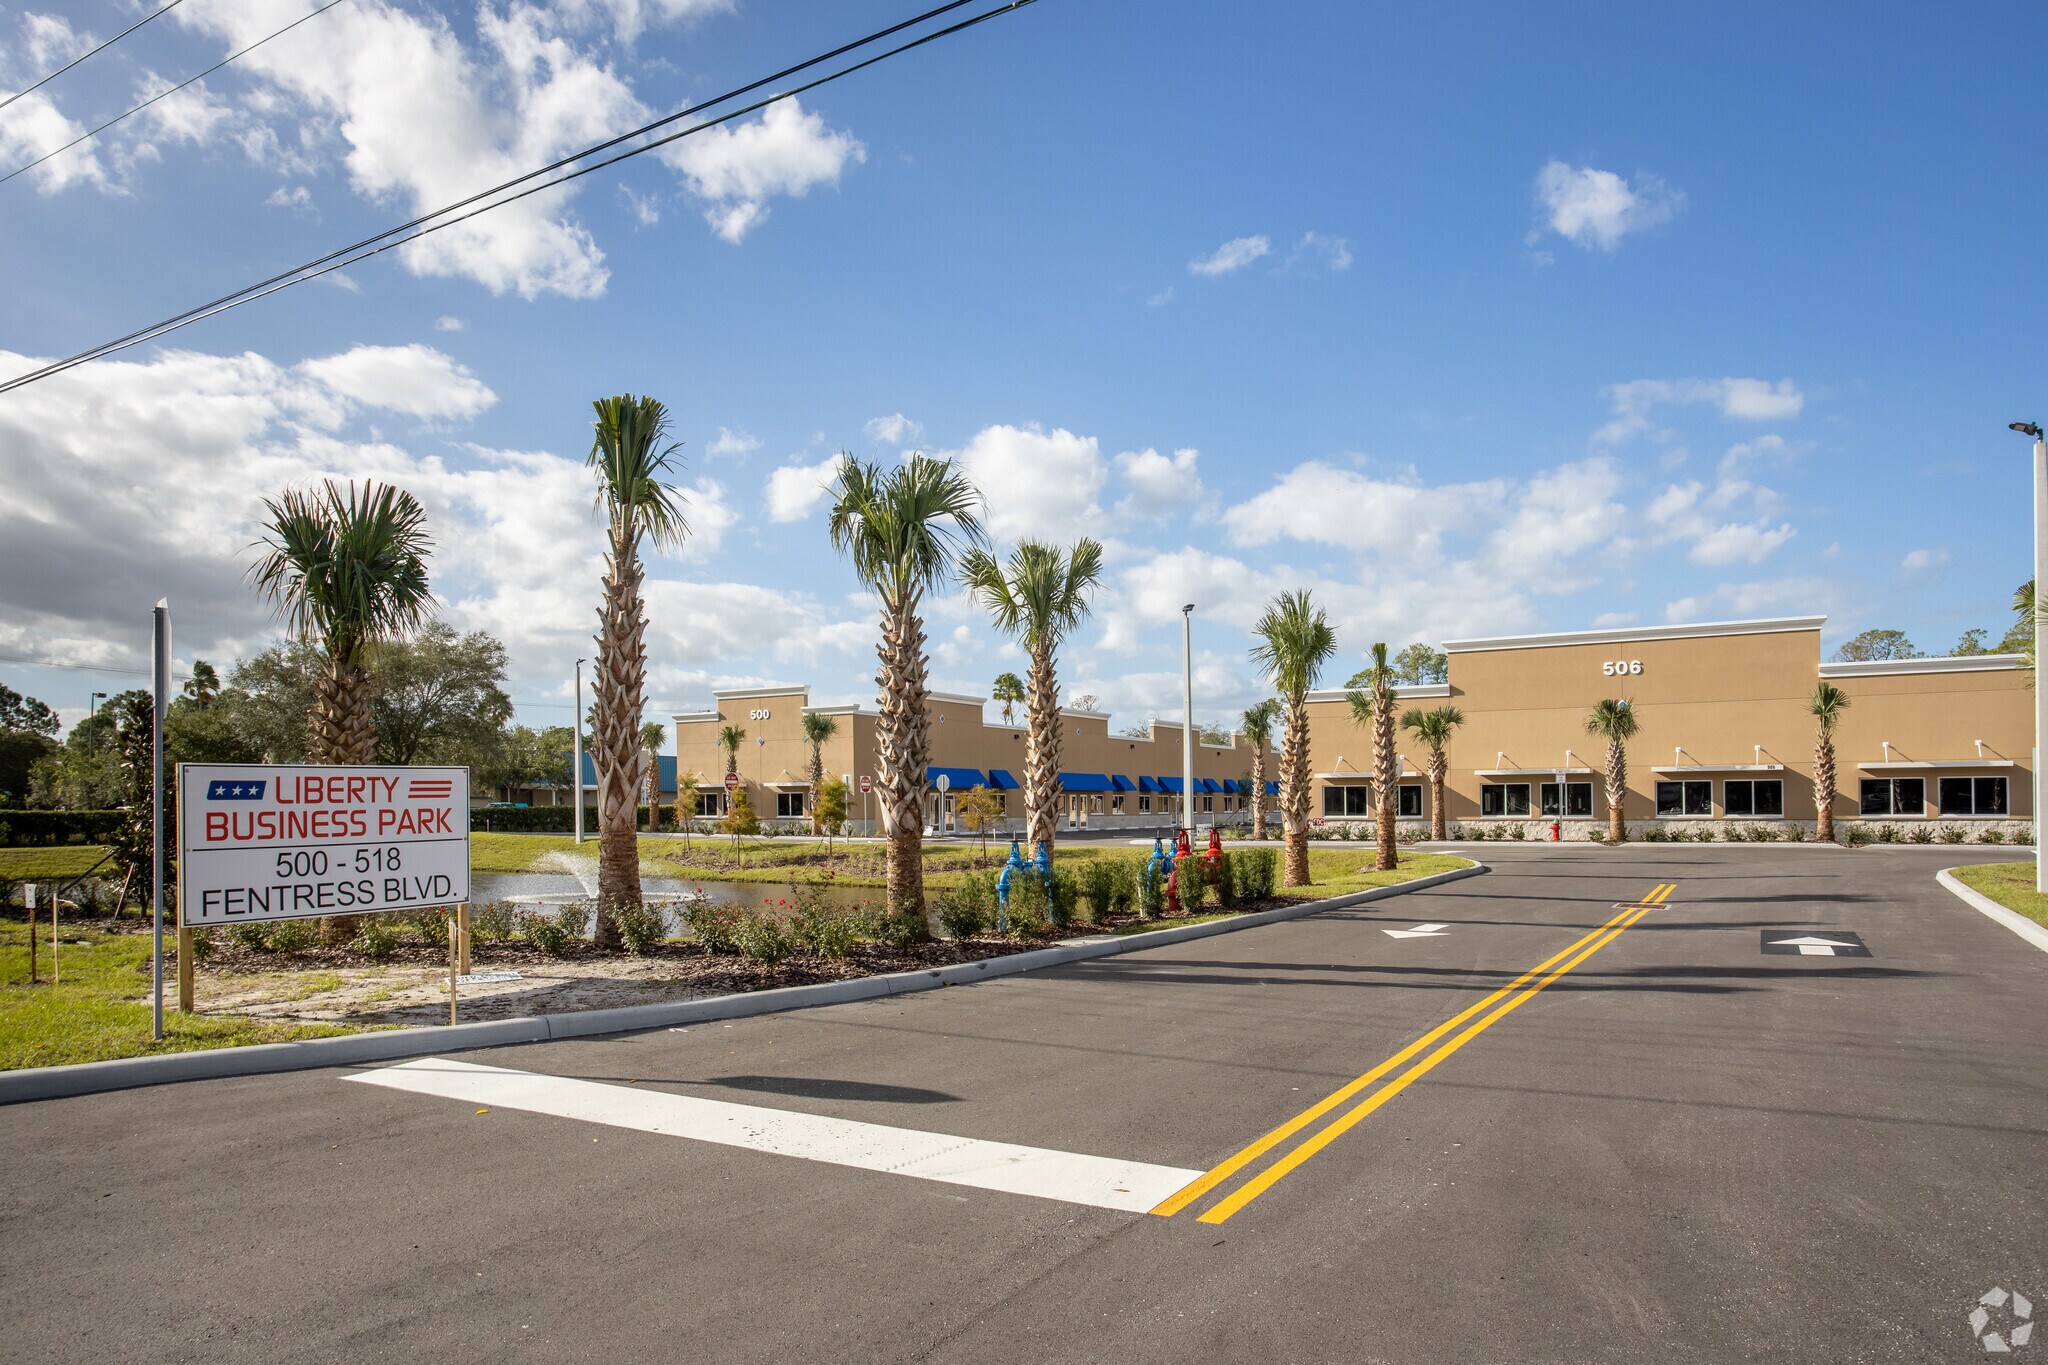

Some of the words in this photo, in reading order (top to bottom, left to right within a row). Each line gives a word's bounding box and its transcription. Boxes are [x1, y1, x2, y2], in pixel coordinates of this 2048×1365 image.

[1603, 660, 1642, 676] 506
[750, 709, 770, 720] 500
[275, 776, 400, 804] LIBERTY
[206, 809, 367, 842] BUSINESS
[378, 807, 453, 836] PARK
[276, 851, 328, 878] 500
[354, 847, 402, 873] 518
[202, 880, 375, 917] FENTRESS
[384, 875, 457, 902] BLVD.
